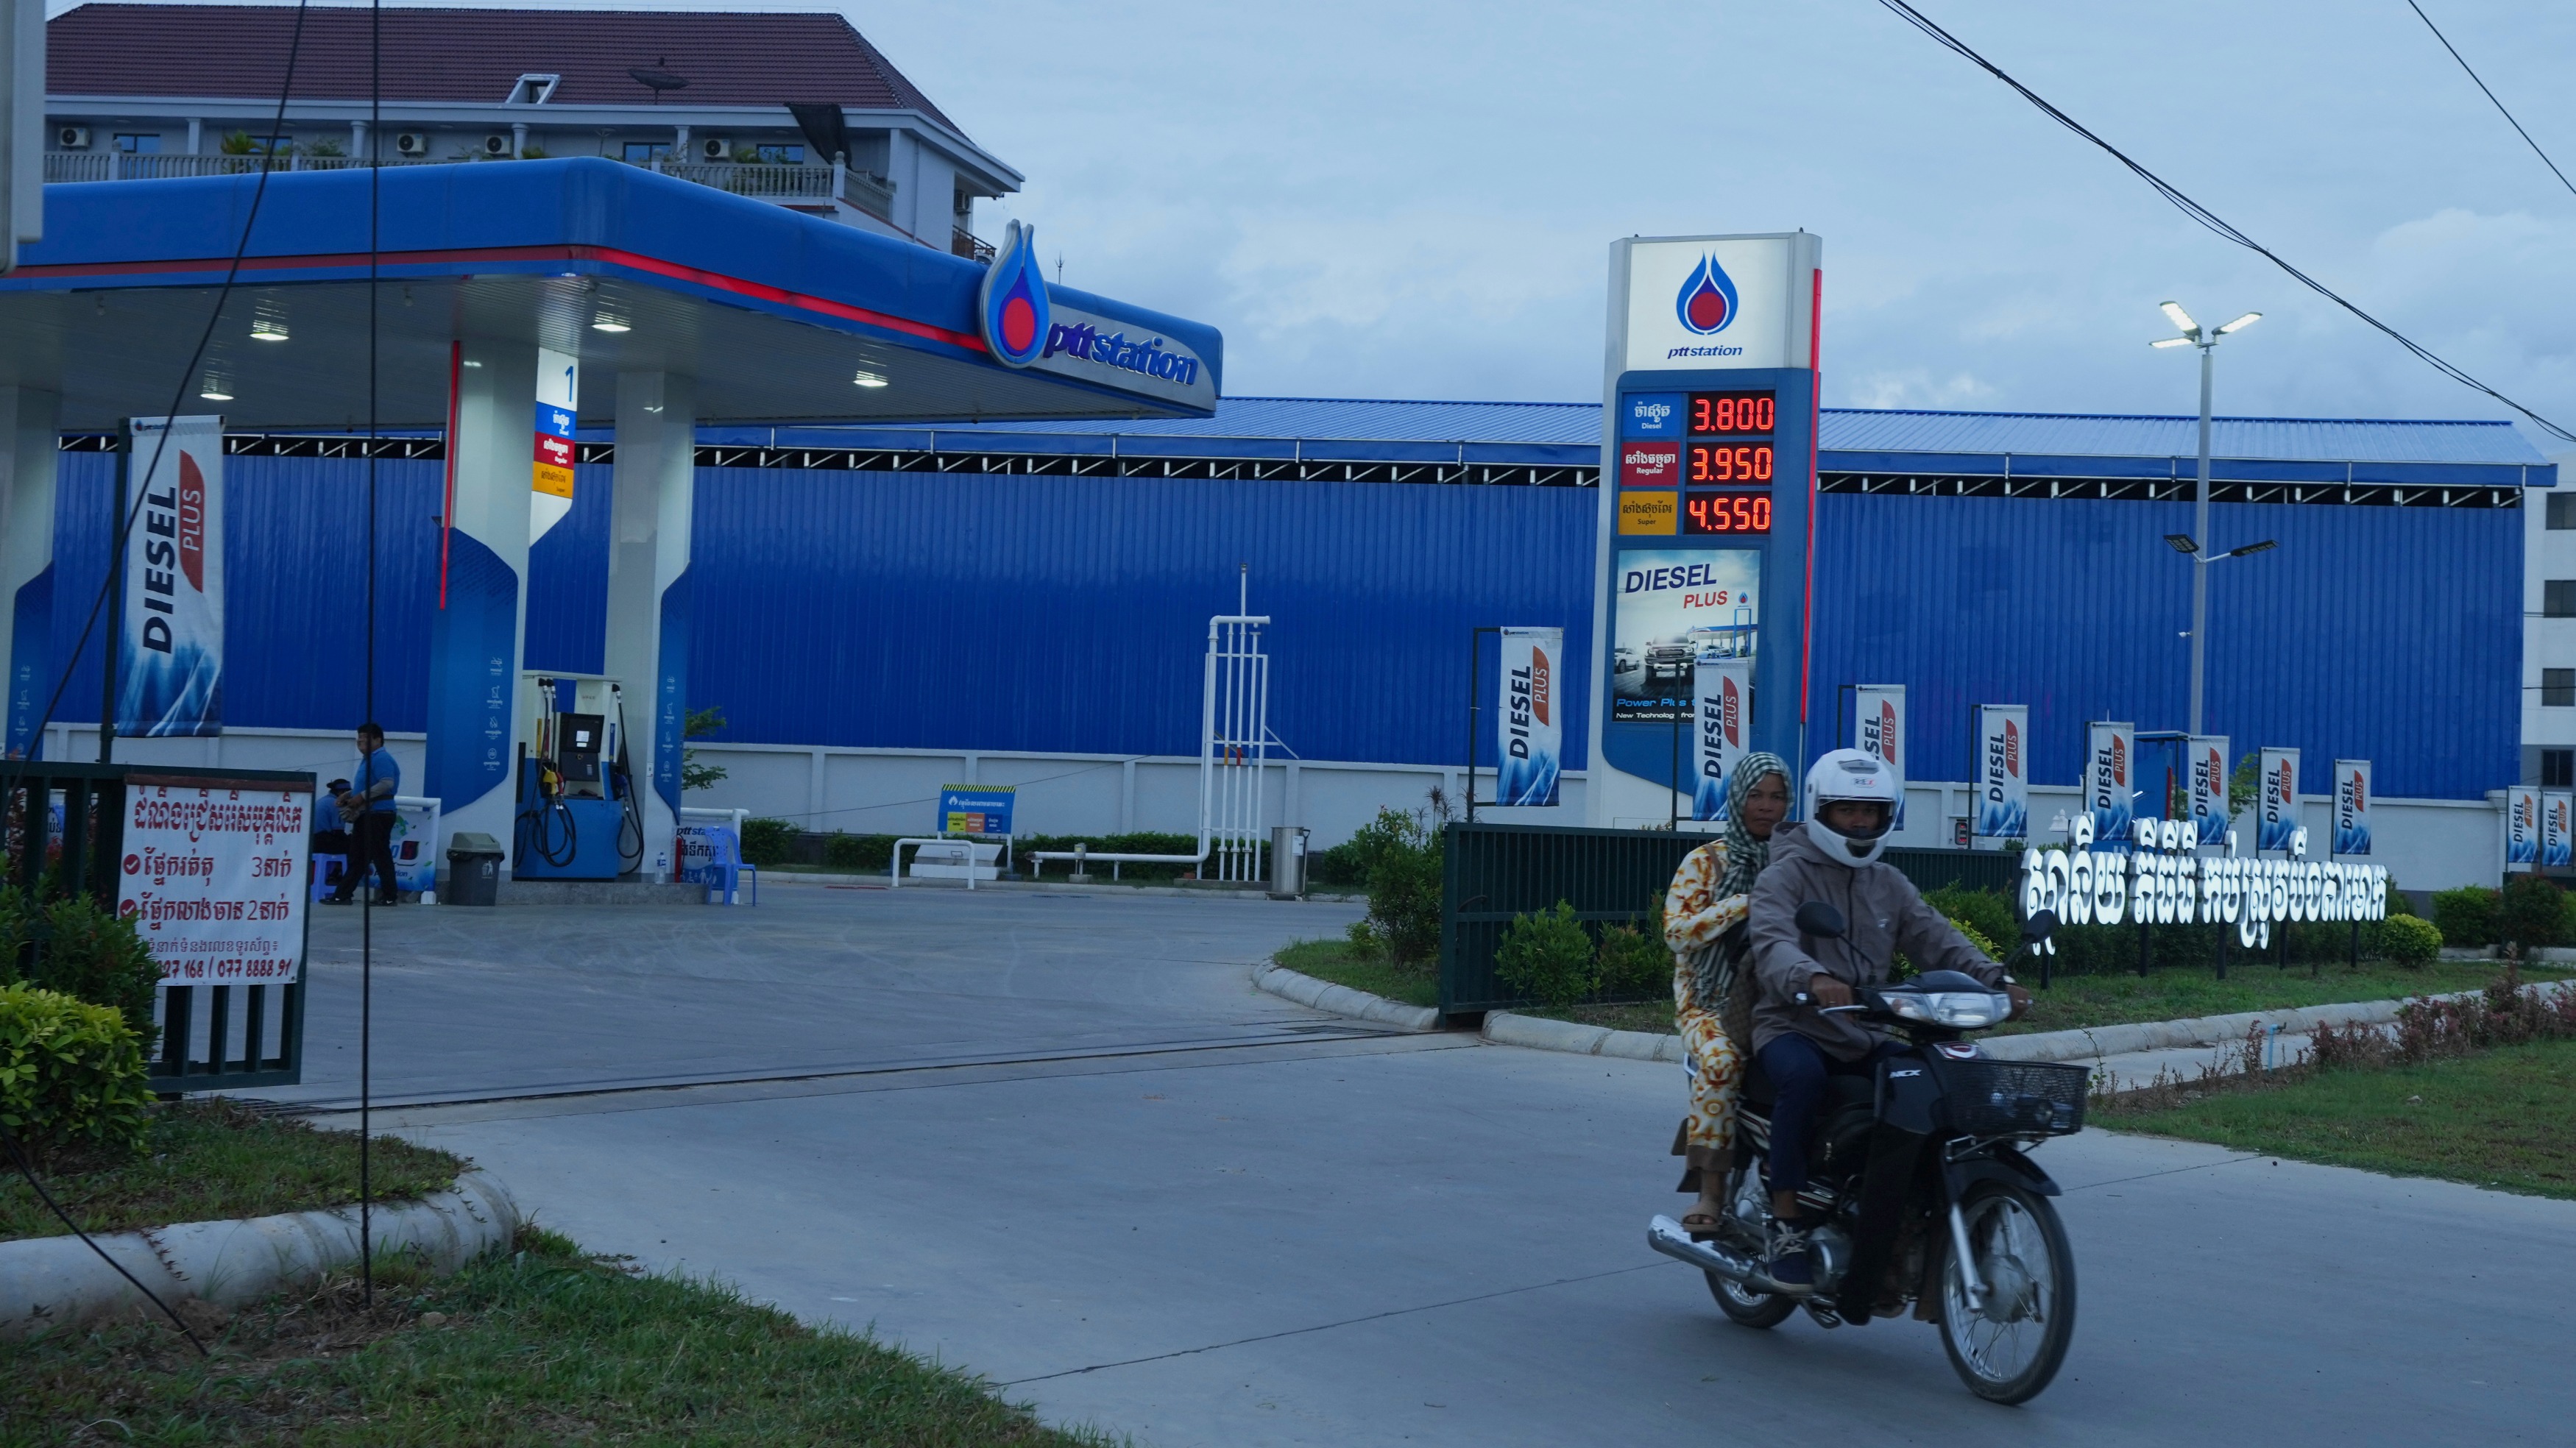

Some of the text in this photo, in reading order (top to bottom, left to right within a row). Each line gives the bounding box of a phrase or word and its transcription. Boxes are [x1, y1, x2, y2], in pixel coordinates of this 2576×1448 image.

[565, 366, 573, 402] 1
[1636, 466, 1663, 476] Regular
[183, 489, 201, 551] PLUS
[1638, 518, 1657, 527] Super
[143, 486, 176, 653] DIESEL
[1625, 564, 1717, 593] DIESEL
[1683, 590, 1728, 608] PLUS
[1535, 667, 1547, 703] PLUS
[1616, 698, 1656, 707] Power
[1510, 666, 1531, 760] DIESEL
[1726, 695, 1736, 728] PLUS
[1704, 694, 1722, 779] DIESEL
[1883, 717, 1894, 747] PLUS
[2007, 734, 2017, 762] PLUS
[1989, 734, 2004, 803] DIESEL
[2098, 747, 2112, 809] DIESEL
[2115, 748, 2125, 773] PLUS
[2211, 760, 2220, 784] PLUS
[2195, 759, 2209, 817] DIESEL
[2267, 769, 2280, 823] DIESEL
[2282, 770, 2290, 792] PLUS
[2341, 781, 2354, 830] DIESEL
[2513, 802, 2524, 843] DIESEL
[2548, 808, 2558, 847] DIESEL
[184, 959, 204, 979] 168
[216, 959, 243, 979] 077
[245, 959, 275, 978] 8888
[277, 958, 293, 977] 91
